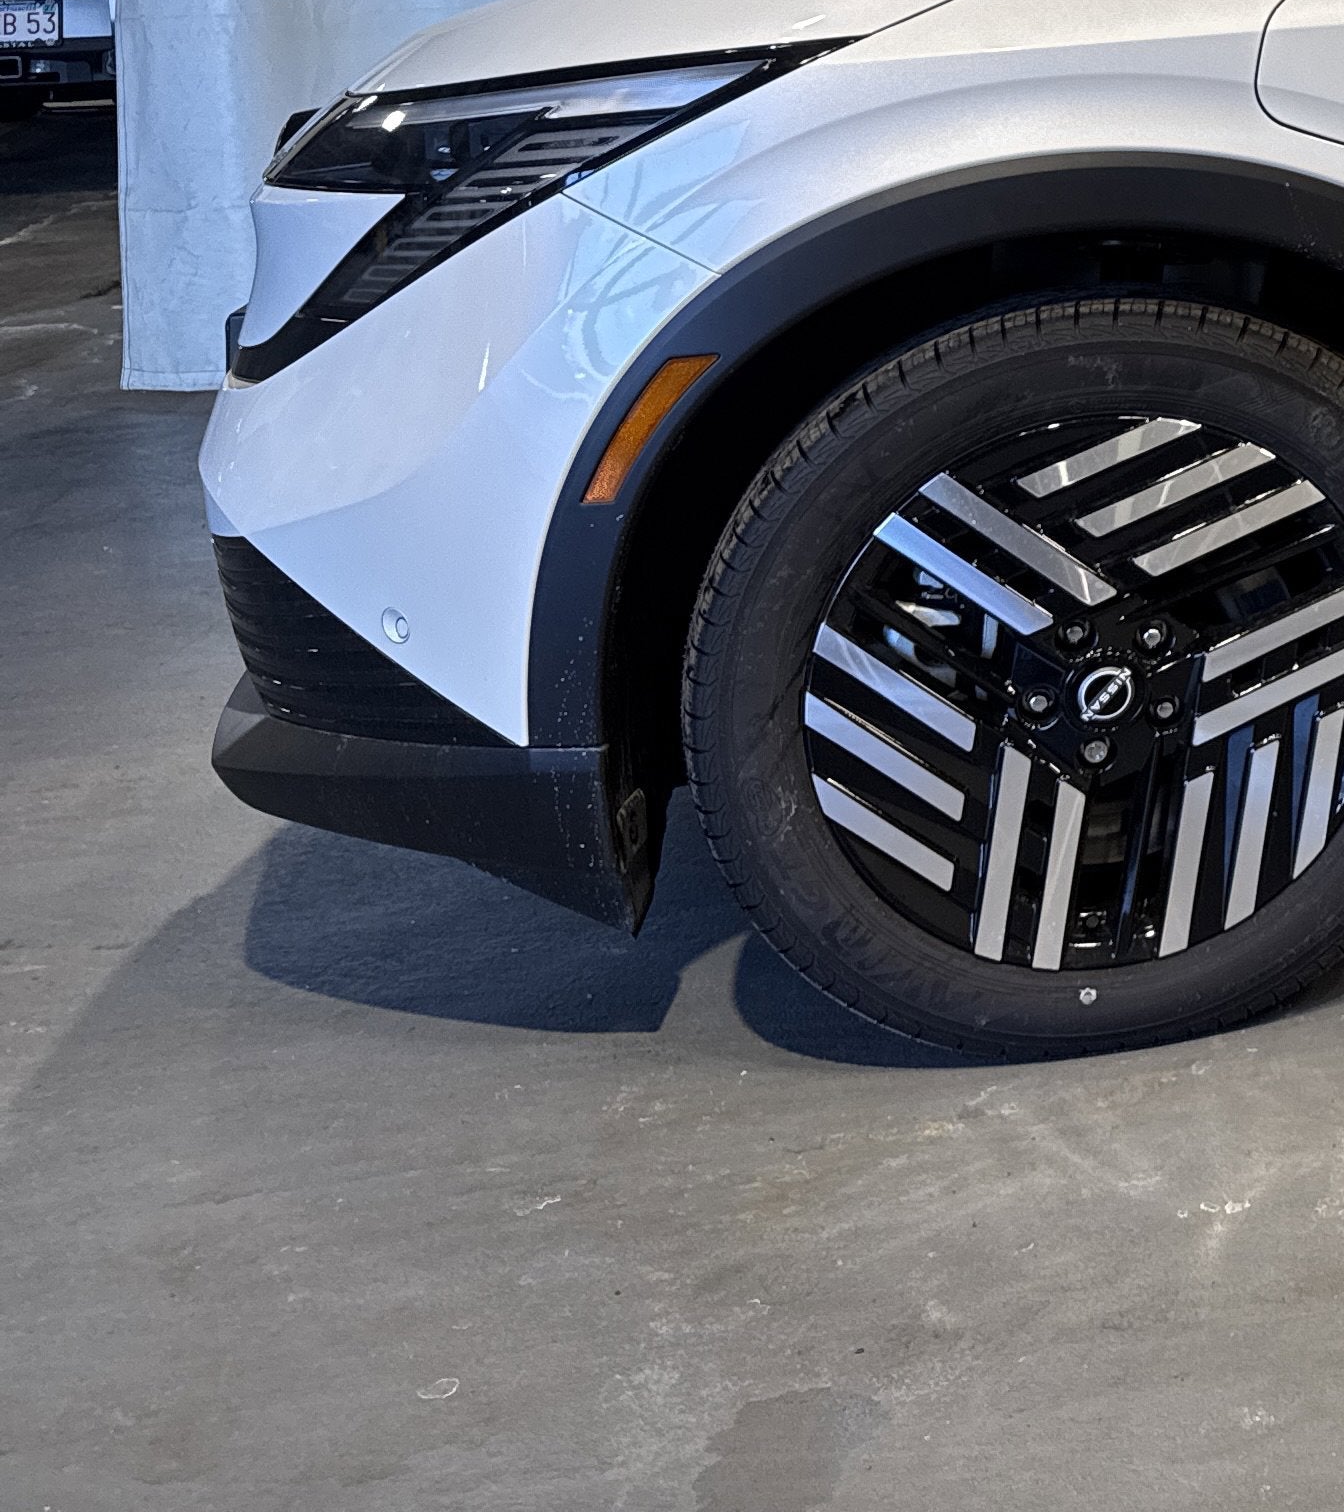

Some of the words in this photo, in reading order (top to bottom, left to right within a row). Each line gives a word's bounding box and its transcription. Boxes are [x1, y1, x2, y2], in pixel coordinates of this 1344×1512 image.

[0, 13, 16, 35] B
[27, 12, 56, 35] 53
[1081, 667, 1132, 722] NISSAN
